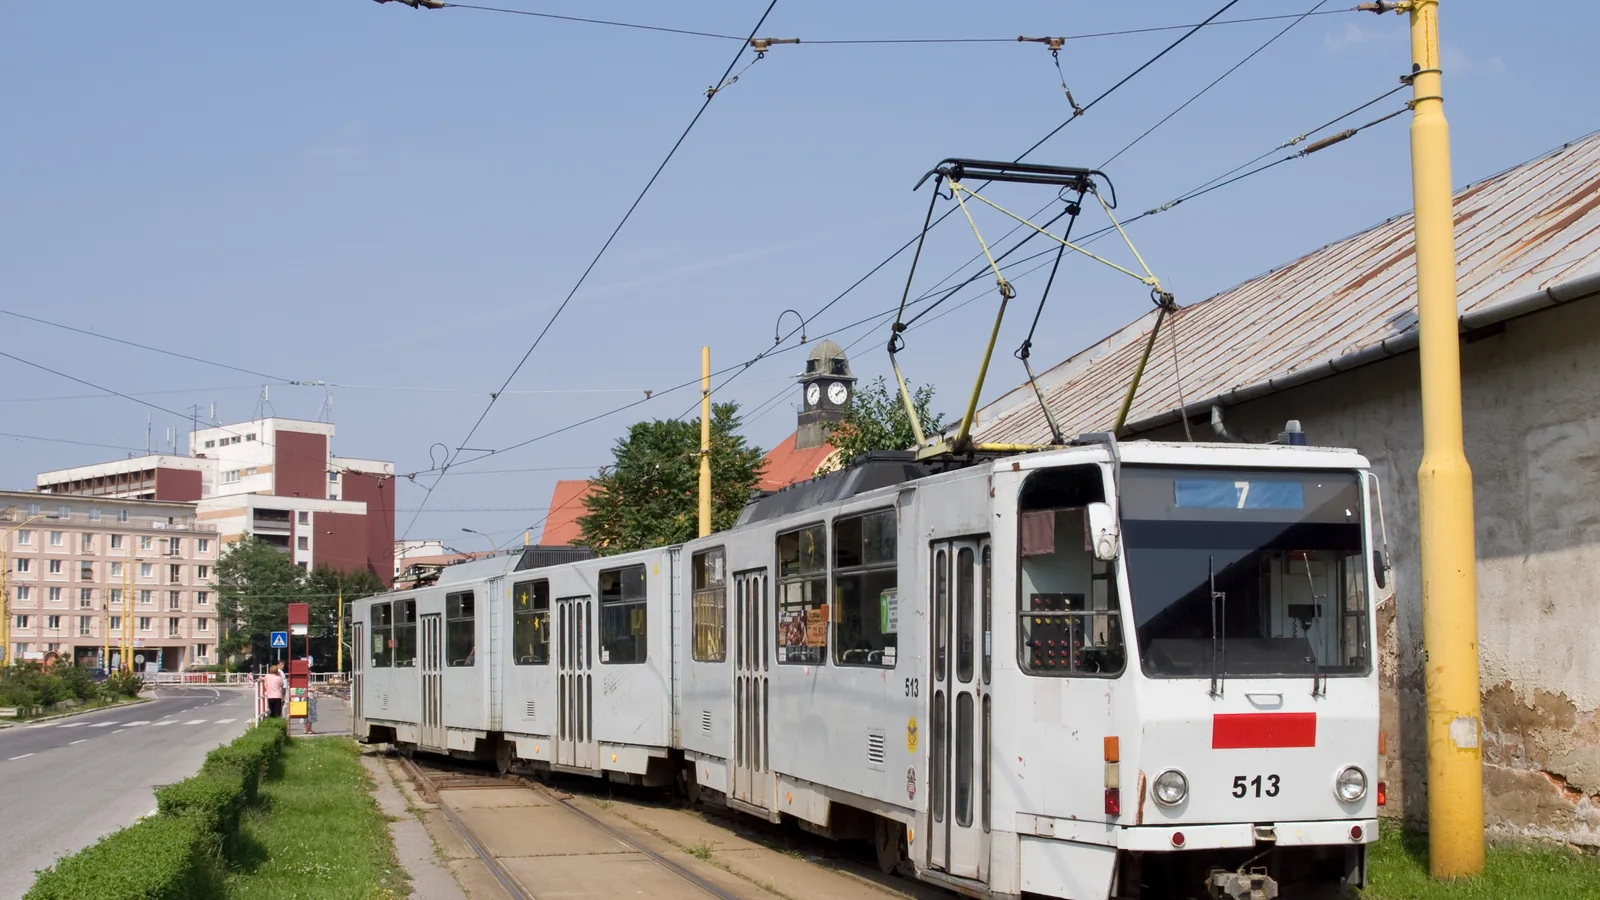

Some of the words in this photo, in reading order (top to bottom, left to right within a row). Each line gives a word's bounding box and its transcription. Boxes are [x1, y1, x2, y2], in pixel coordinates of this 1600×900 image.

[1234, 481, 1250, 509] 7
[905, 677, 919, 698] 513
[1231, 774, 1281, 799] 513
